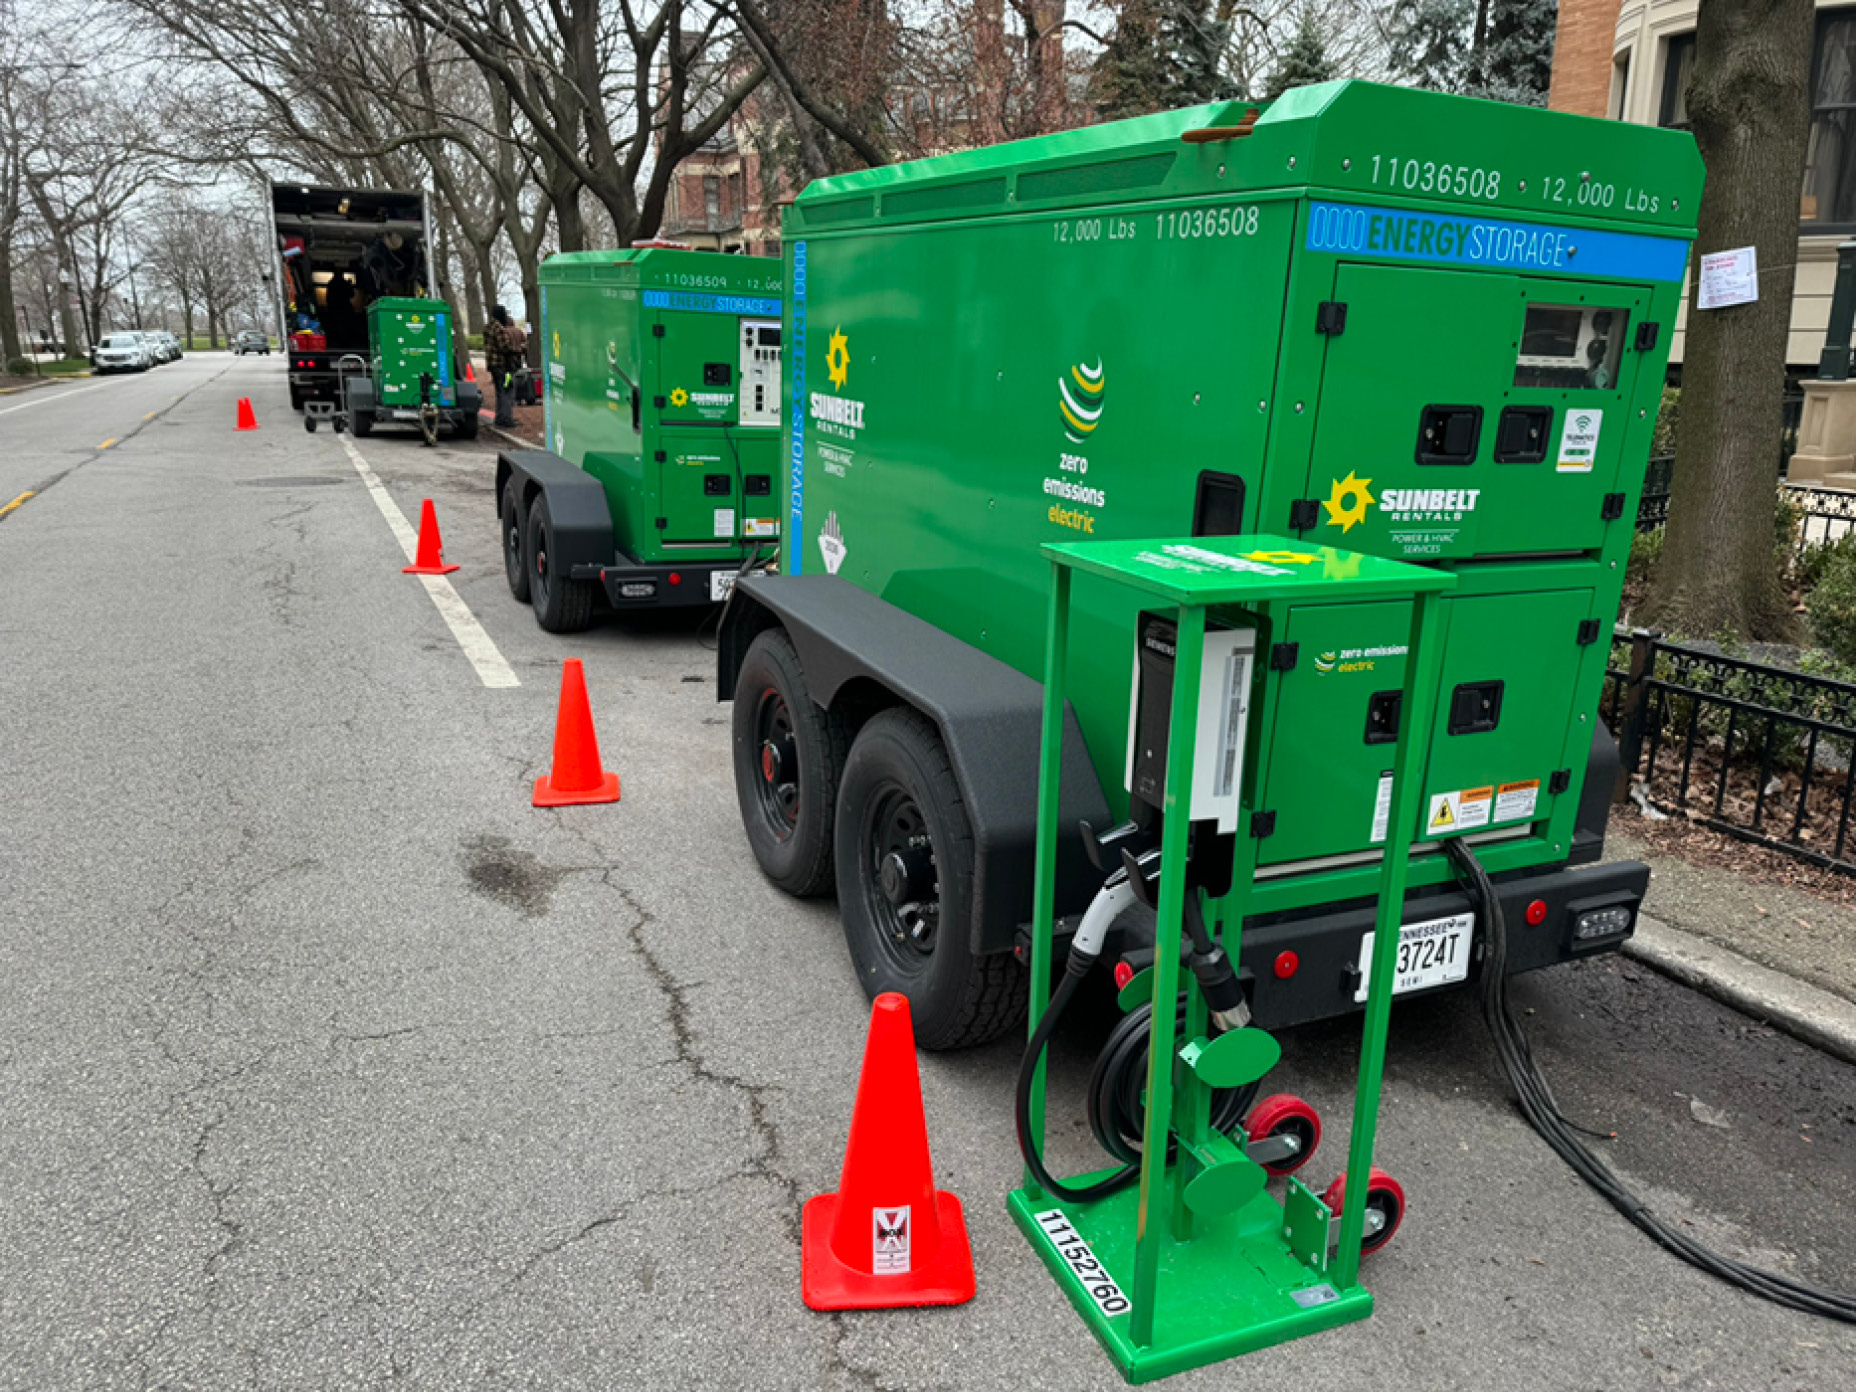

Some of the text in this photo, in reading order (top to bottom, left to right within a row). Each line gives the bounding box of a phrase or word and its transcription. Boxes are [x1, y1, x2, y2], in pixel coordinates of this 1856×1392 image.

[1371, 154, 1660, 213] 11036508 12,000 Lbs
[1053, 217, 1137, 244] 12,000 Lbs
[1156, 206, 1259, 240] 11036508
[665, 272, 727, 288] 11036509
[809, 391, 865, 430] SUNBELT
[1060, 453, 1088, 474] zero
[1043, 477, 1105, 507] emissions
[1379, 488, 1480, 511] SUNBELT
[1048, 503, 1094, 534] electric
[1391, 512, 1462, 522] RENTALS
[1340, 644, 1409, 659] zero emission
[1338, 660, 1376, 672] electric
[1397, 933, 1460, 974] 3724T
[1041, 1211, 1129, 1312] 11152760
